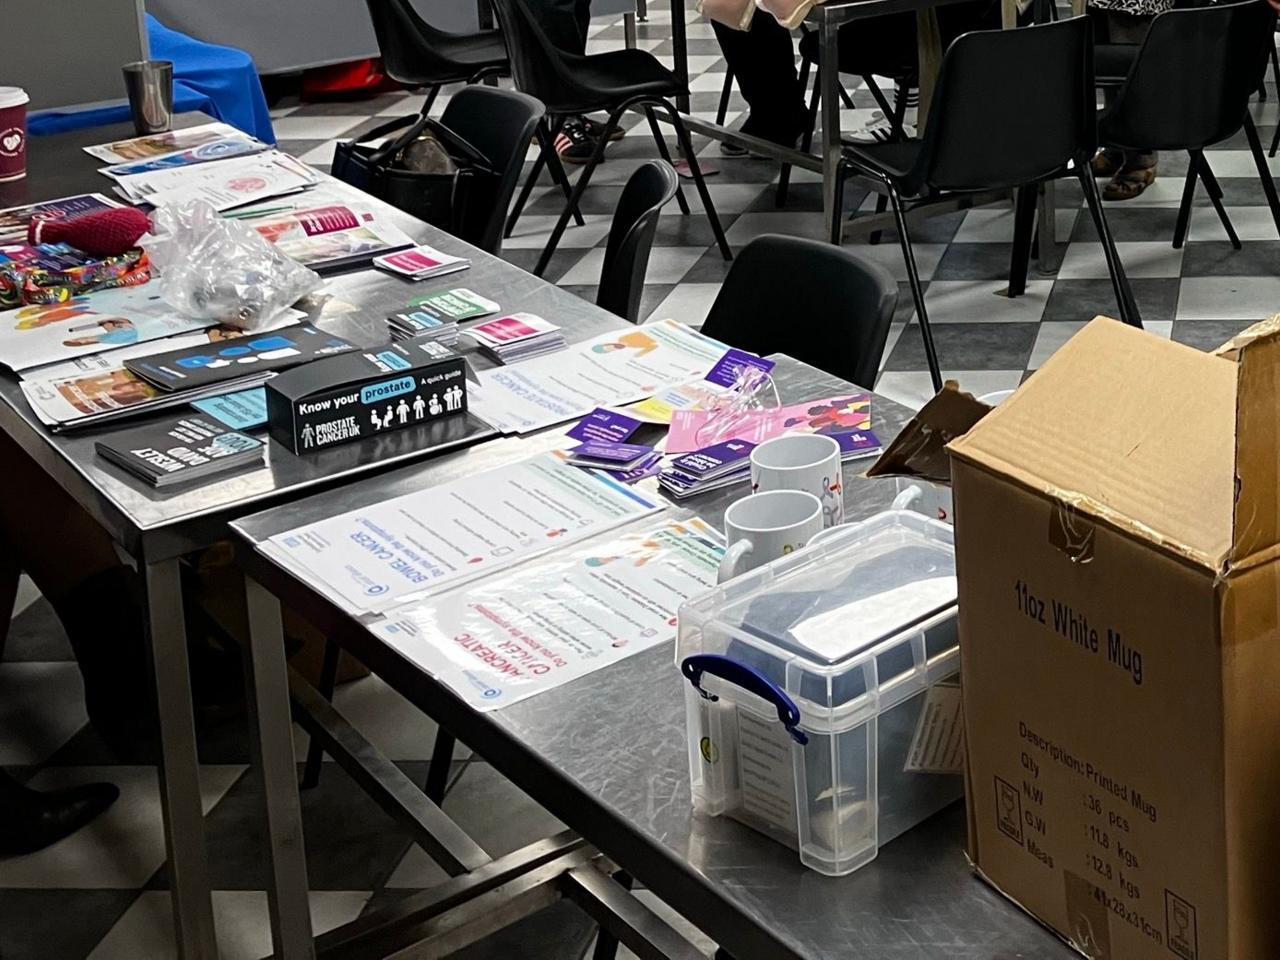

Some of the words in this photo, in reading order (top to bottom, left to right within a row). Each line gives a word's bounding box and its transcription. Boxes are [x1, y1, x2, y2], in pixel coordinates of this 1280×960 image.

[427, 374, 444, 385] quick
[444, 370, 462, 382] guide
[299, 401, 332, 416] Know
[334, 392, 360, 409] your
[365, 381, 411, 400] prostate
[315, 416, 356, 434] PROSTATE
[316, 426, 350, 446] CANCER
[349, 424, 360, 438] UK
[130, 448, 186, 472] WESLEY
[166, 446, 210, 466] DAVID
[346, 531, 397, 560] CANCER
[397, 547, 424, 561] know
[385, 558, 429, 583] BOWEL
[516, 635, 543, 650] know
[1015, 580, 1046, 624] 11oz
[1052, 600, 1099, 654] White
[1108, 628, 1143, 686] Mug
[451, 632, 526, 678] ANCREATIC
[1019, 722, 1084, 775] Description:
[1086, 762, 1128, 800] Printed
[1131, 792, 1157, 822] Mug
[1021, 752, 1040, 778] Qty
[1109, 810, 1130, 832] pcs
[1022, 781, 1044, 806] N.W
[1118, 841, 1138, 869] kgs
[1025, 810, 1046, 836] G.W
[1119, 872, 1141, 900] kgs
[1027, 840, 1054, 870] Meas
